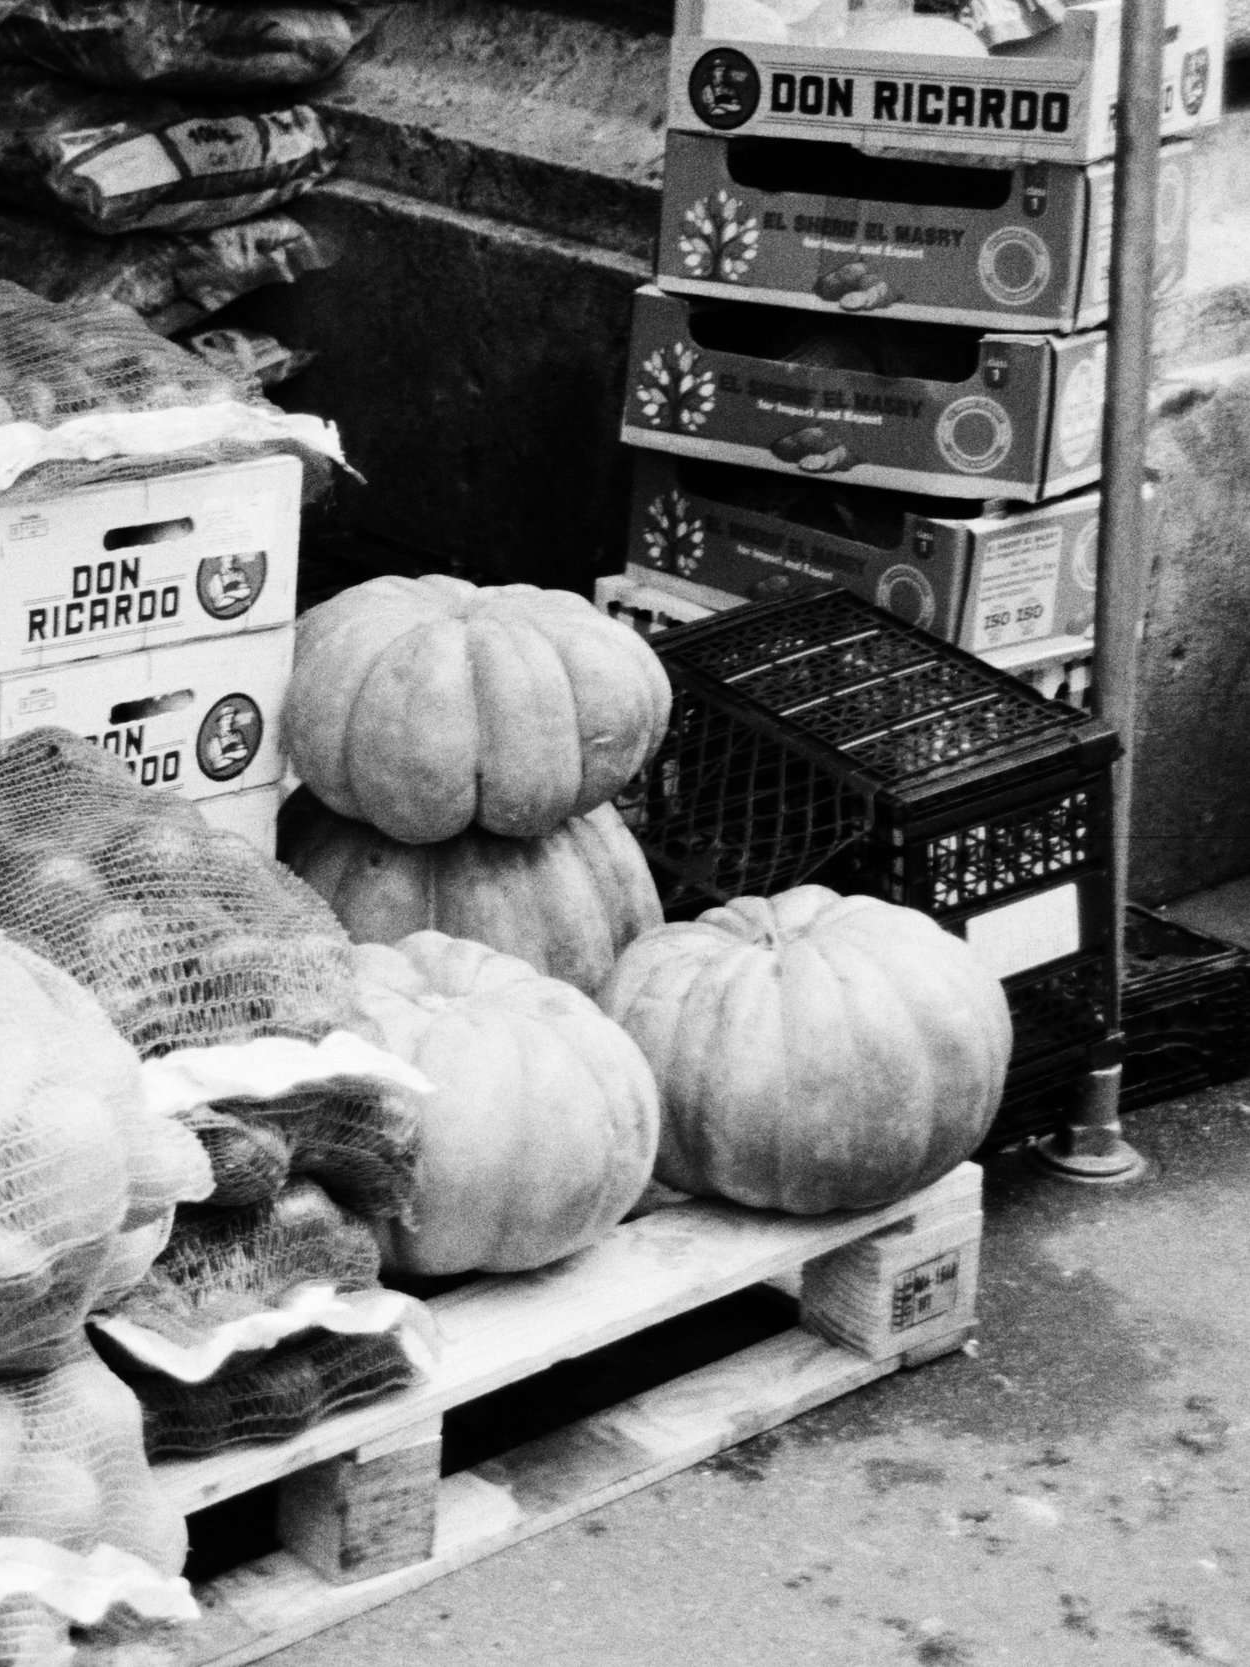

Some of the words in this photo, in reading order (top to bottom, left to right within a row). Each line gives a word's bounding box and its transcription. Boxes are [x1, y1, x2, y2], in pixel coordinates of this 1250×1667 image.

[770, 73, 854, 117] DON
[873, 80, 1071, 133] RICARDO
[763, 211, 786, 231] EL
[864, 222, 888, 242] EL
[816, 410, 842, 421] and
[72, 556, 141, 599] DON
[28, 585, 180, 643] RICARDO
[1015, 604, 1044, 622] ISO
